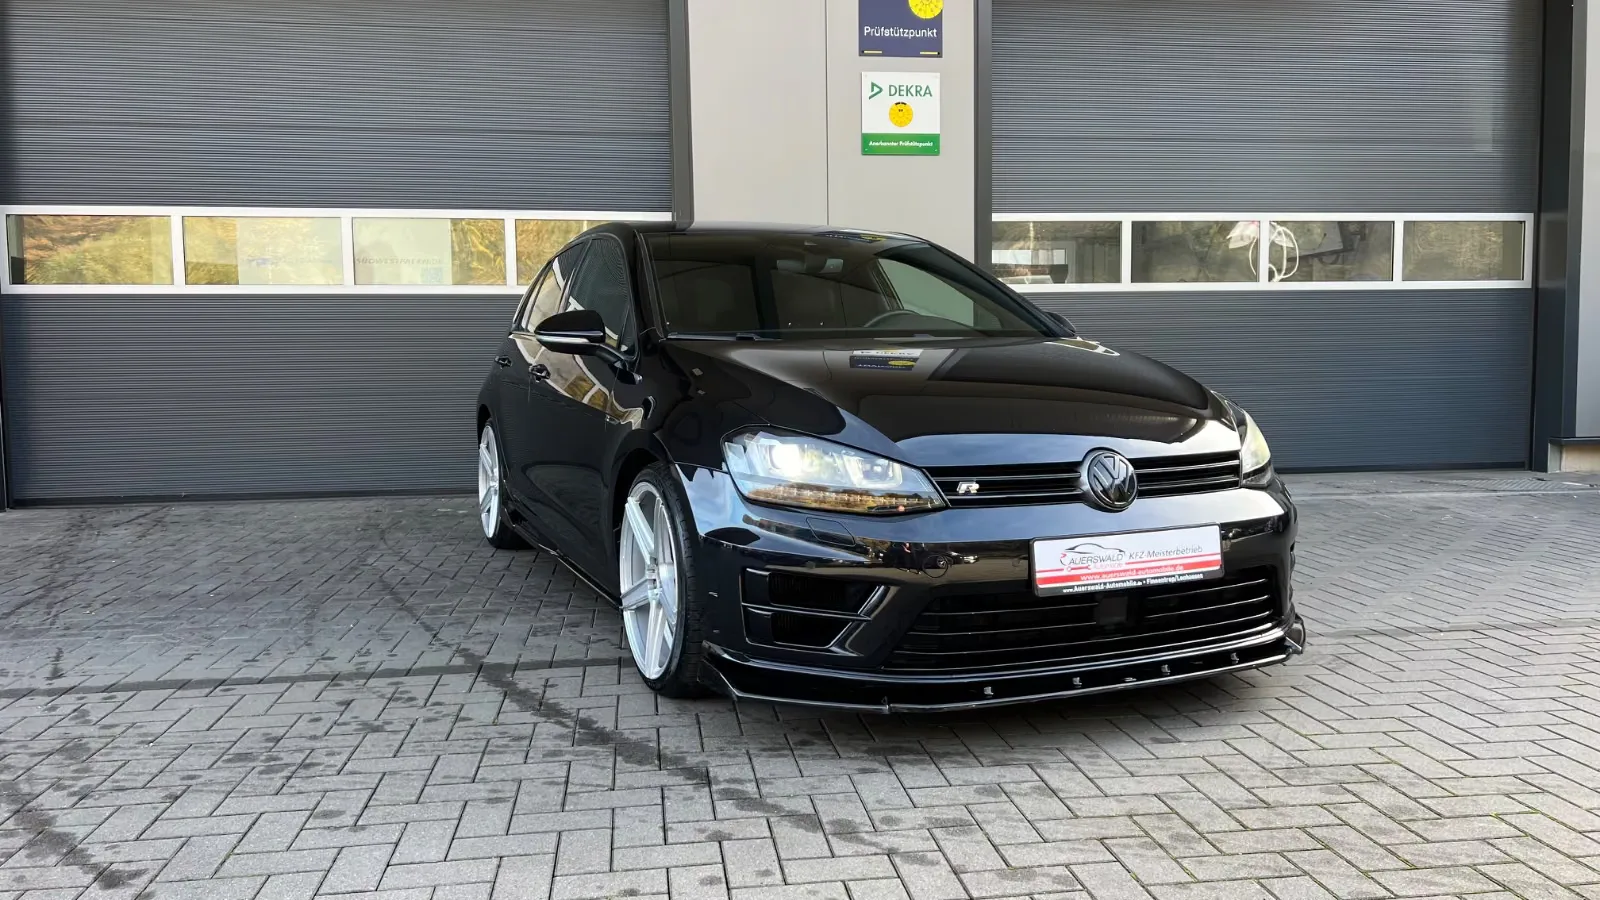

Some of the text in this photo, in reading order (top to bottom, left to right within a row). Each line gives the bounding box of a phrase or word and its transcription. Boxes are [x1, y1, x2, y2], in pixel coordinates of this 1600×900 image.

[864, 26, 937, 39] Prüfstützpunkt
[888, 84, 933, 97] DEKRA
[956, 481, 980, 494] R
[1069, 545, 1203, 566] AUERSWALD KFZ-Meisterbetrieb
[1080, 565, 1184, 581] www.auerswald-automobile.de
